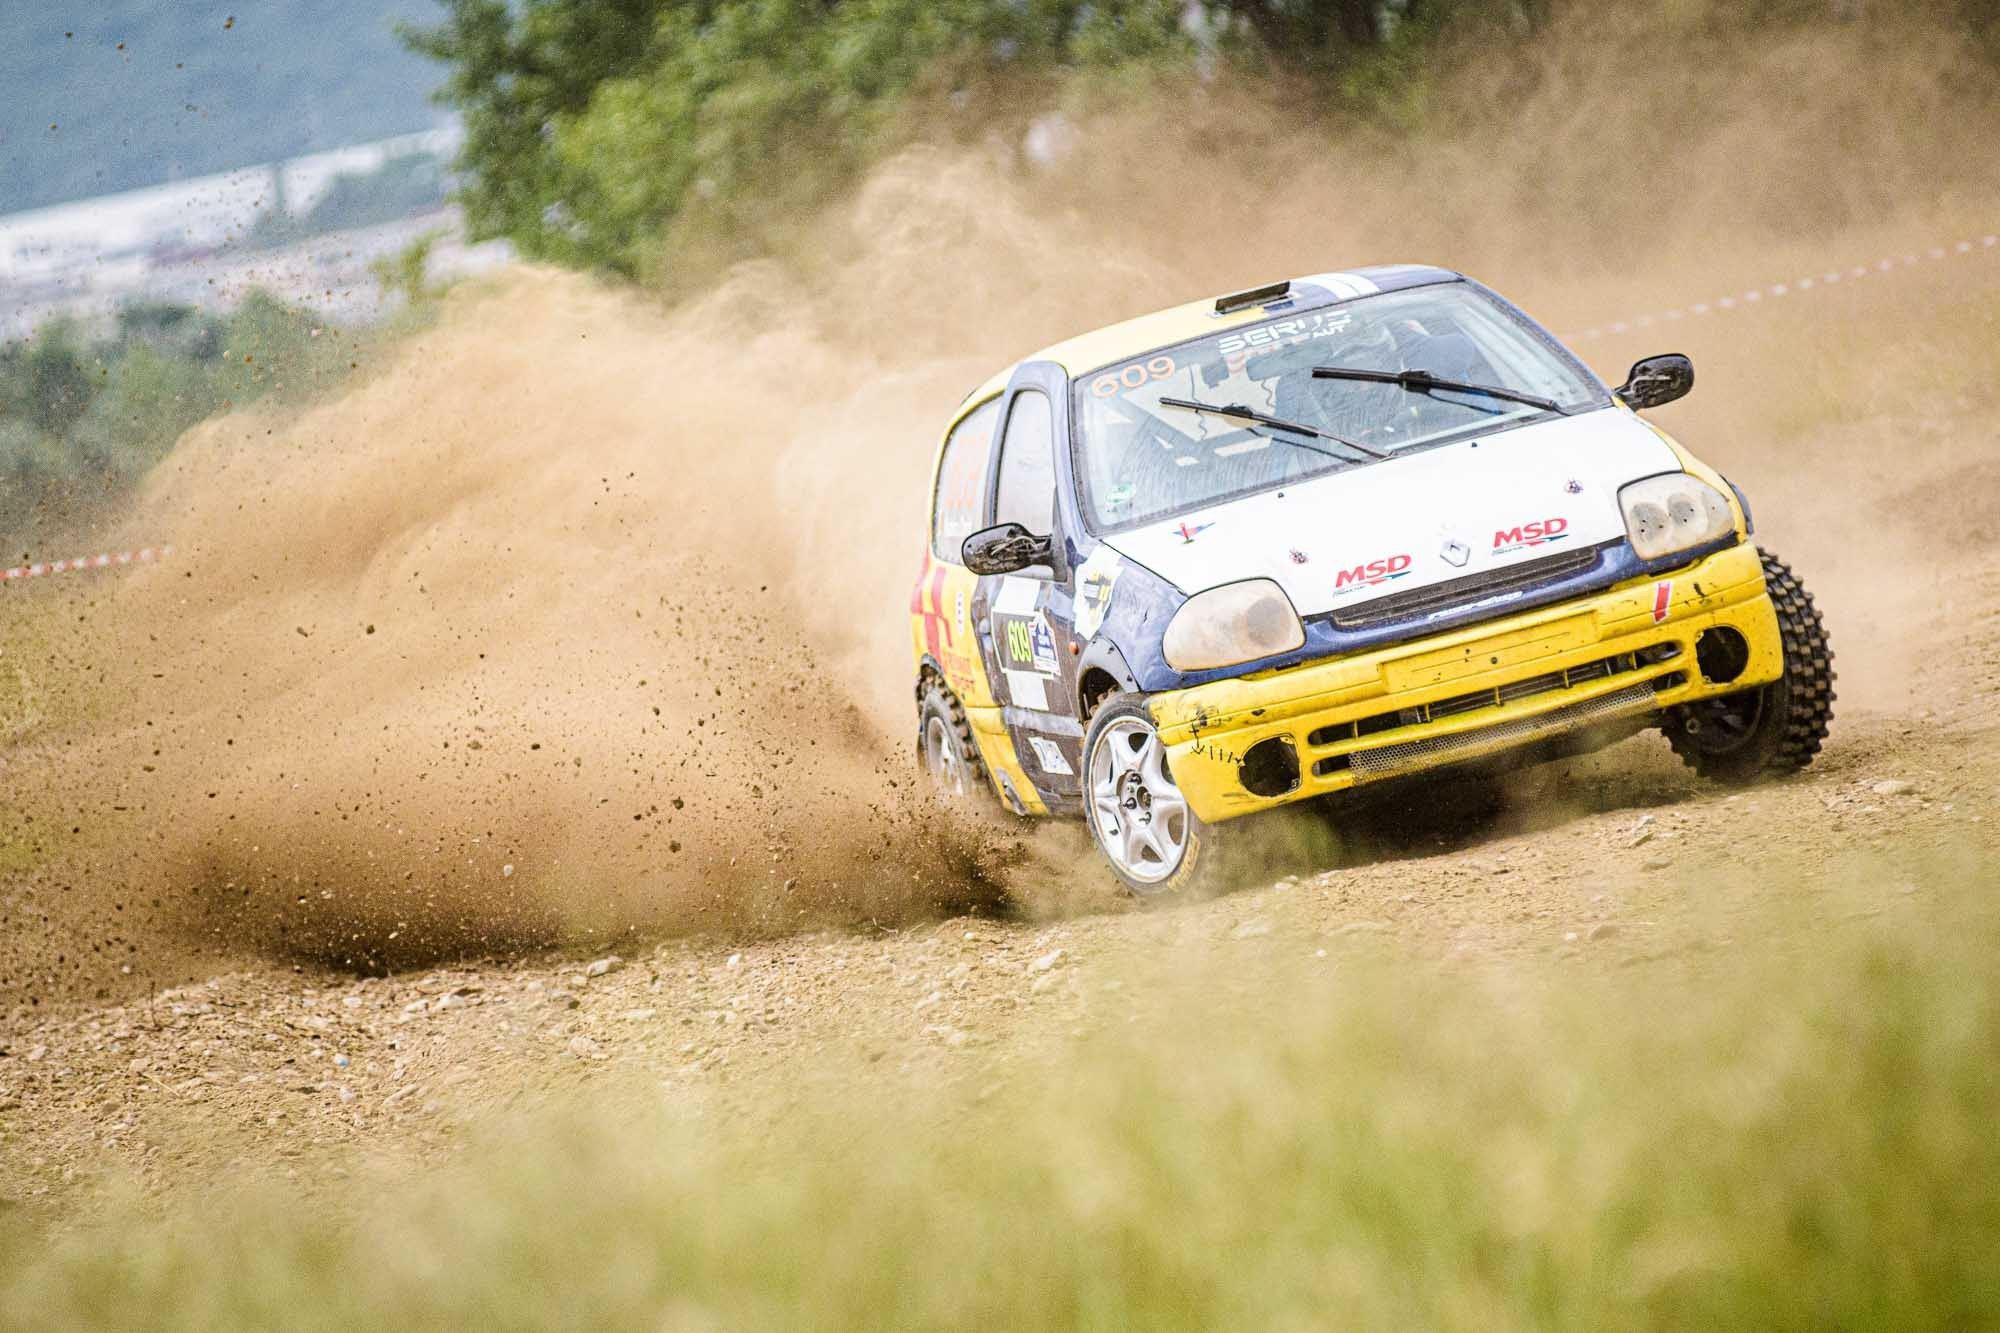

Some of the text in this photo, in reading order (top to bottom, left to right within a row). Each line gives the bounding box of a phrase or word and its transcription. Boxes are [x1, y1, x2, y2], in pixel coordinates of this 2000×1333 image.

[1091, 356, 1176, 398] 609
[1494, 518, 1567, 548] MSD
[1335, 555, 1411, 587] MSD
[1008, 619, 1031, 662] 609
